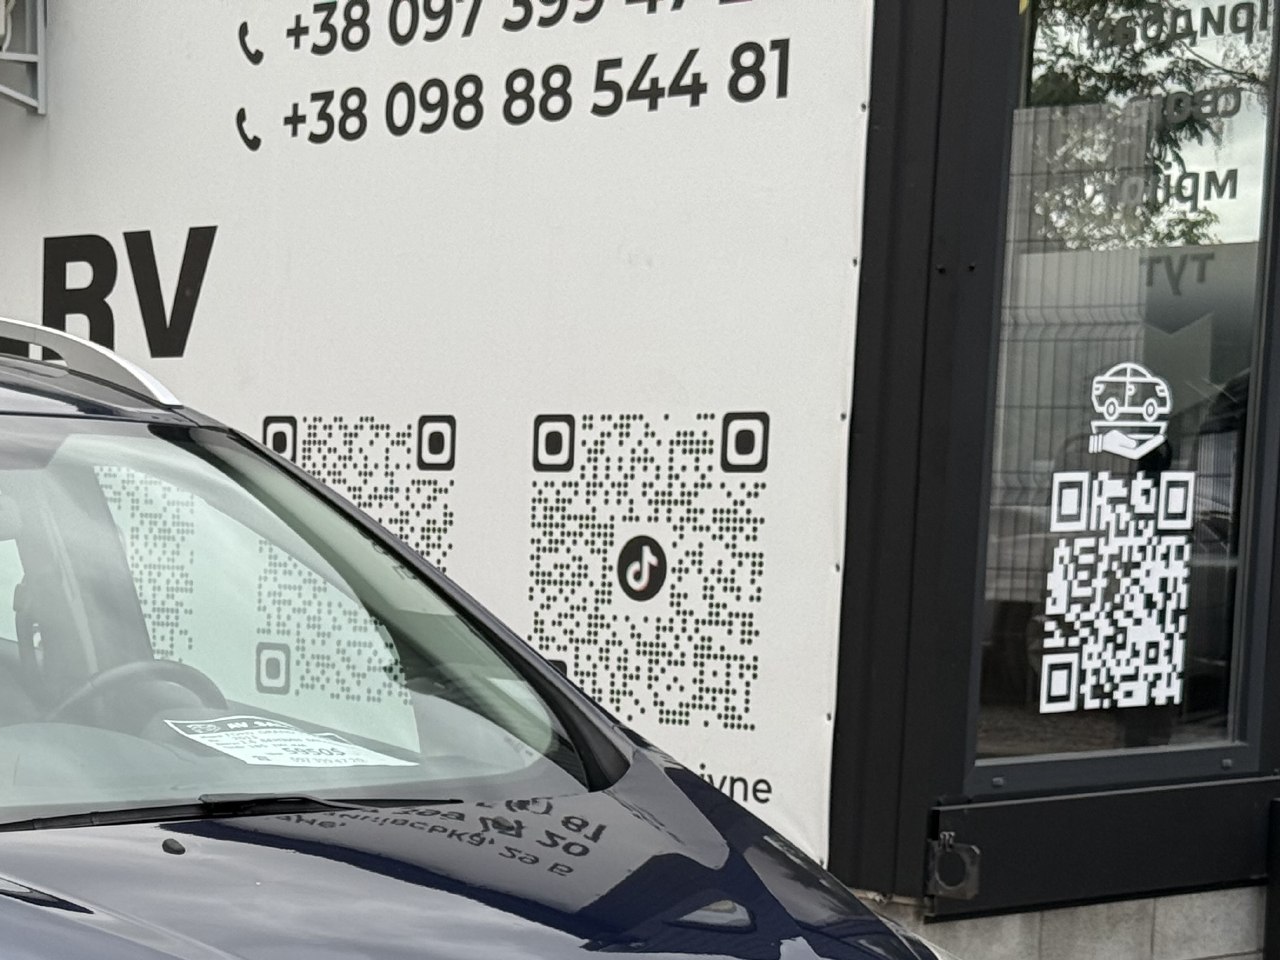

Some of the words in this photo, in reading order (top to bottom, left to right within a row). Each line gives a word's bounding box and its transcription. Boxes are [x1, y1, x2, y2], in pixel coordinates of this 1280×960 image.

[286, 0, 371, 56] +38
[388, 0, 483, 46] 097
[283, 87, 368, 144] +38
[385, 74, 484, 137] 098
[502, 64, 572, 126] 88
[590, 48, 708, 118] 544
[727, 38, 791, 103] 81
